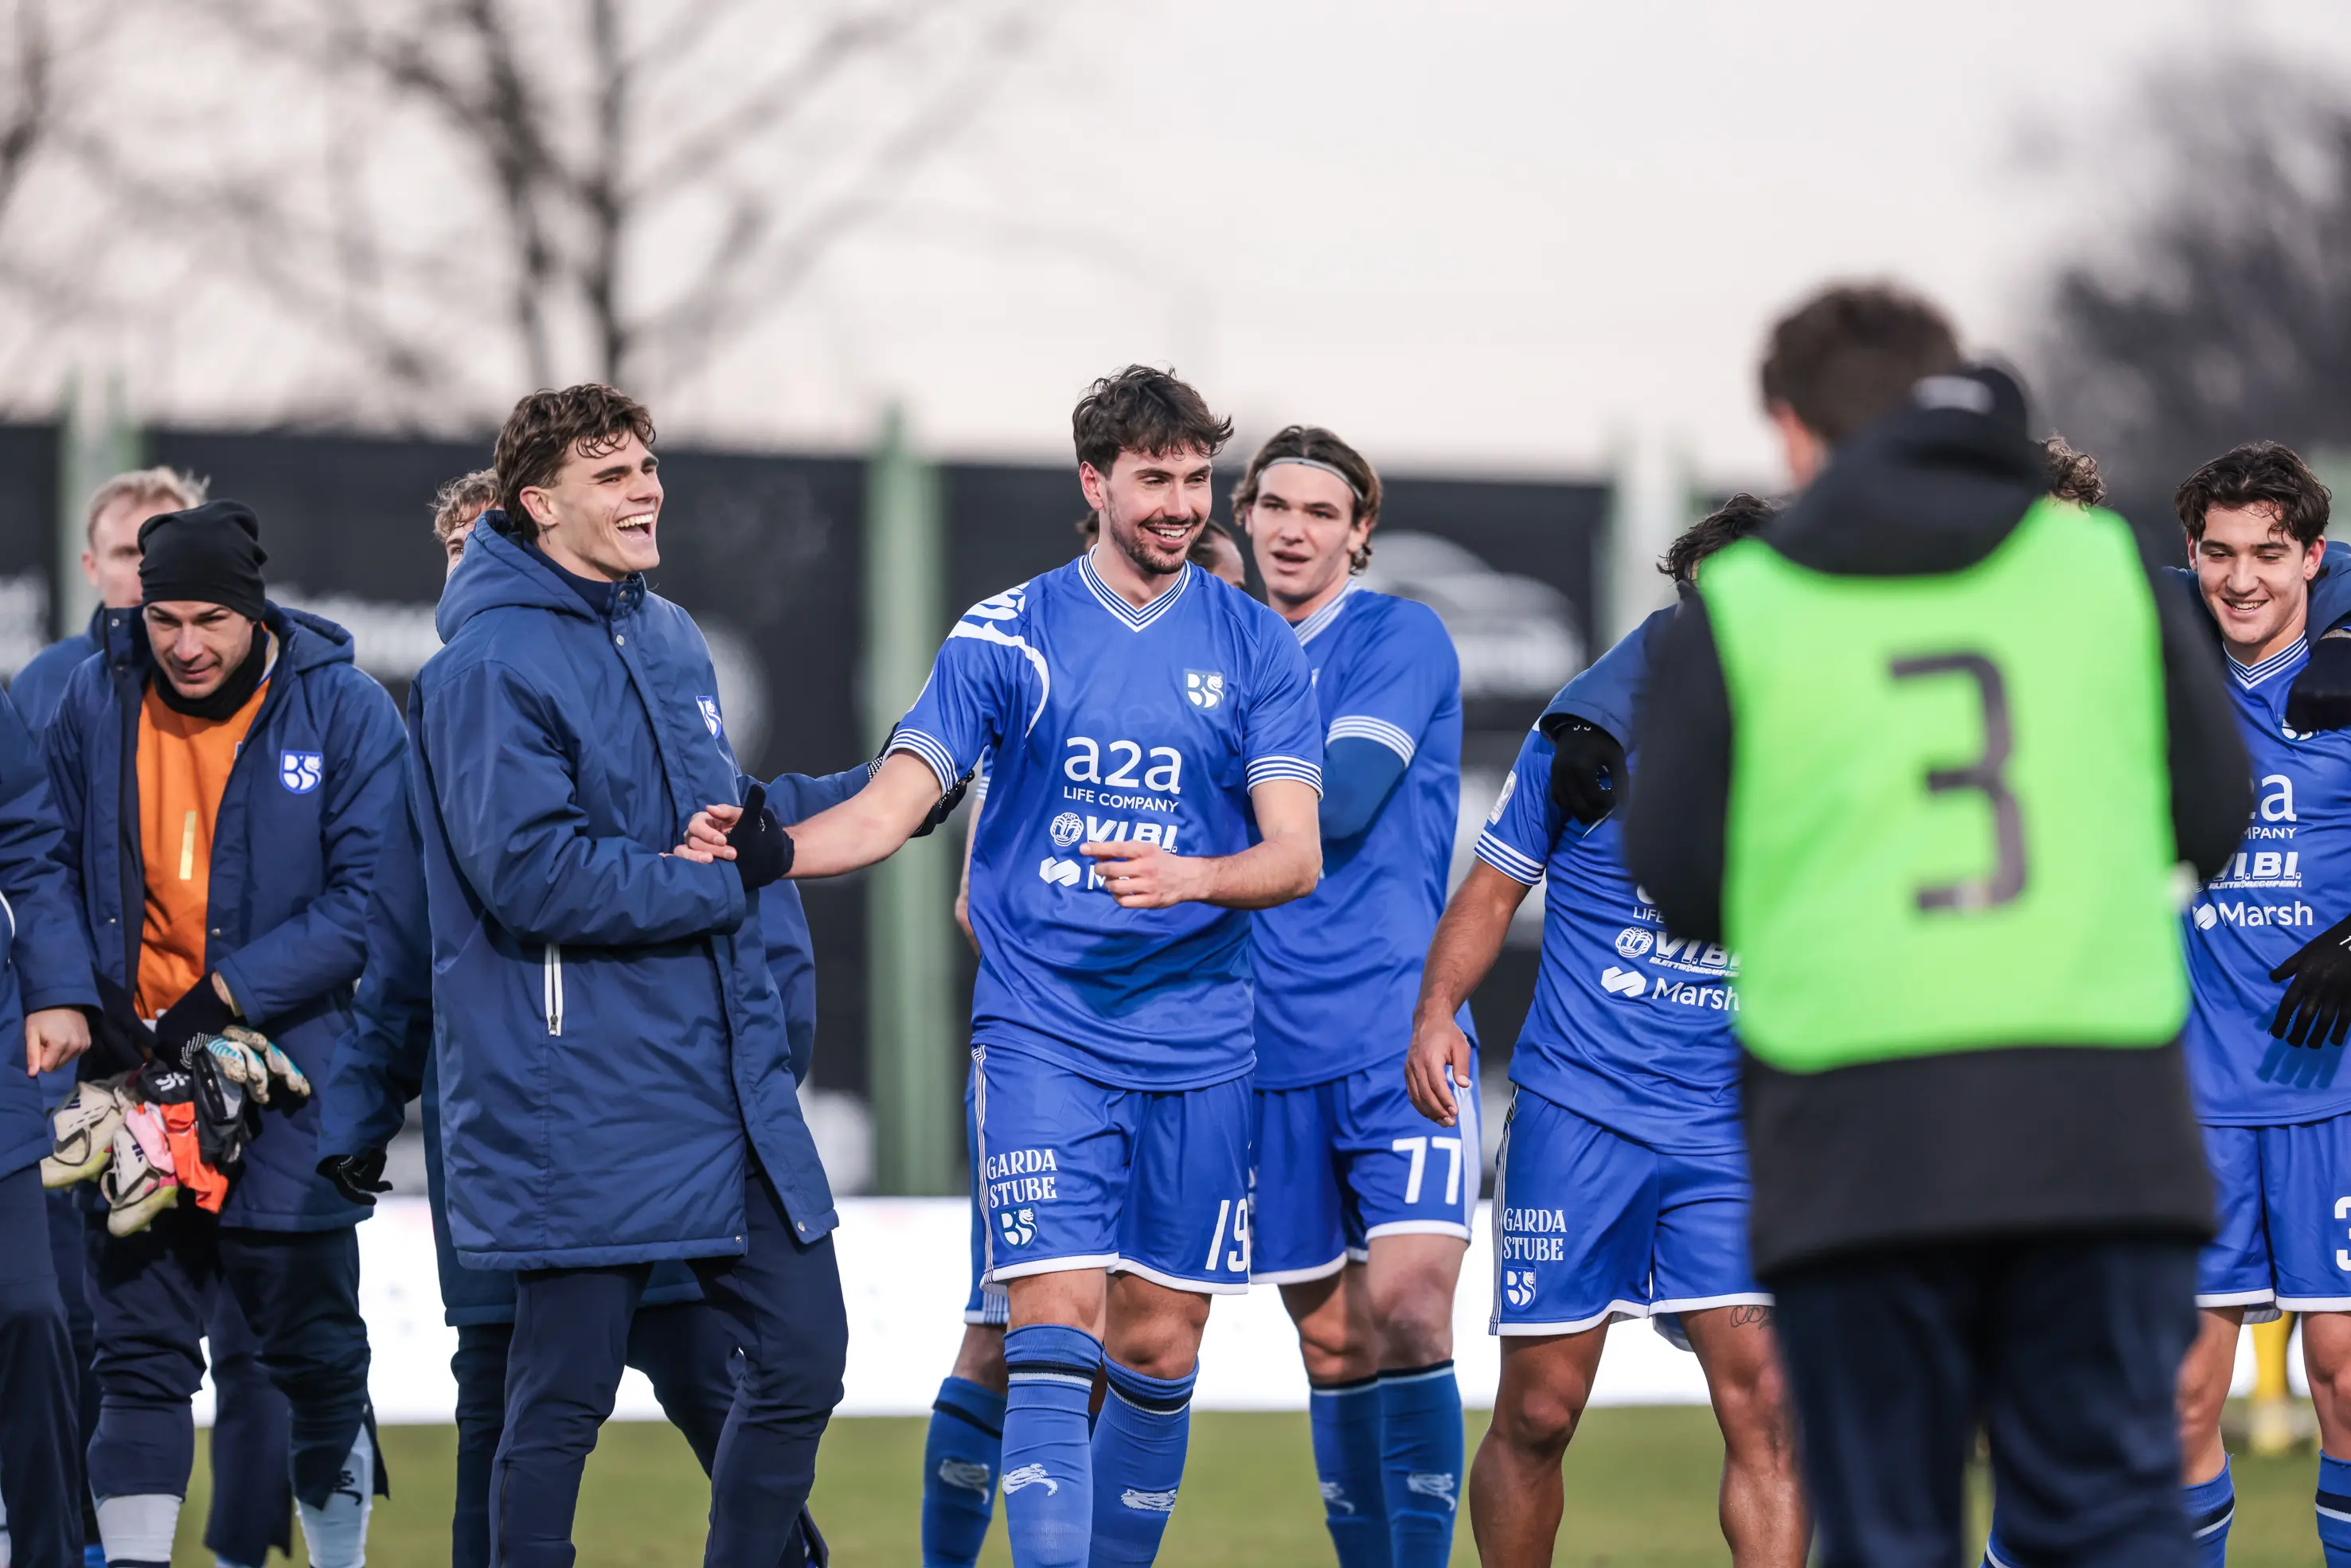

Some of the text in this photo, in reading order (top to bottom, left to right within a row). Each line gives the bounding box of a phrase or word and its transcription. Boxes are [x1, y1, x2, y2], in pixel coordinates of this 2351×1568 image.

[1064, 736, 1182, 794] a2a
[1890, 652, 2027, 912] 3
[1063, 786, 1180, 813] LIFE COMPANY
[2218, 900, 2314, 928] Marsh
[1651, 977, 1741, 1012] Marsh
[986, 1149, 1058, 1180] GARDA
[1392, 1136, 1463, 1206] 77
[990, 1176, 1058, 1209] STUBE
[1205, 1198, 1248, 1273] 19
[1502, 1207, 1568, 1234] GARDA
[1503, 1235, 1564, 1262] STUBE
